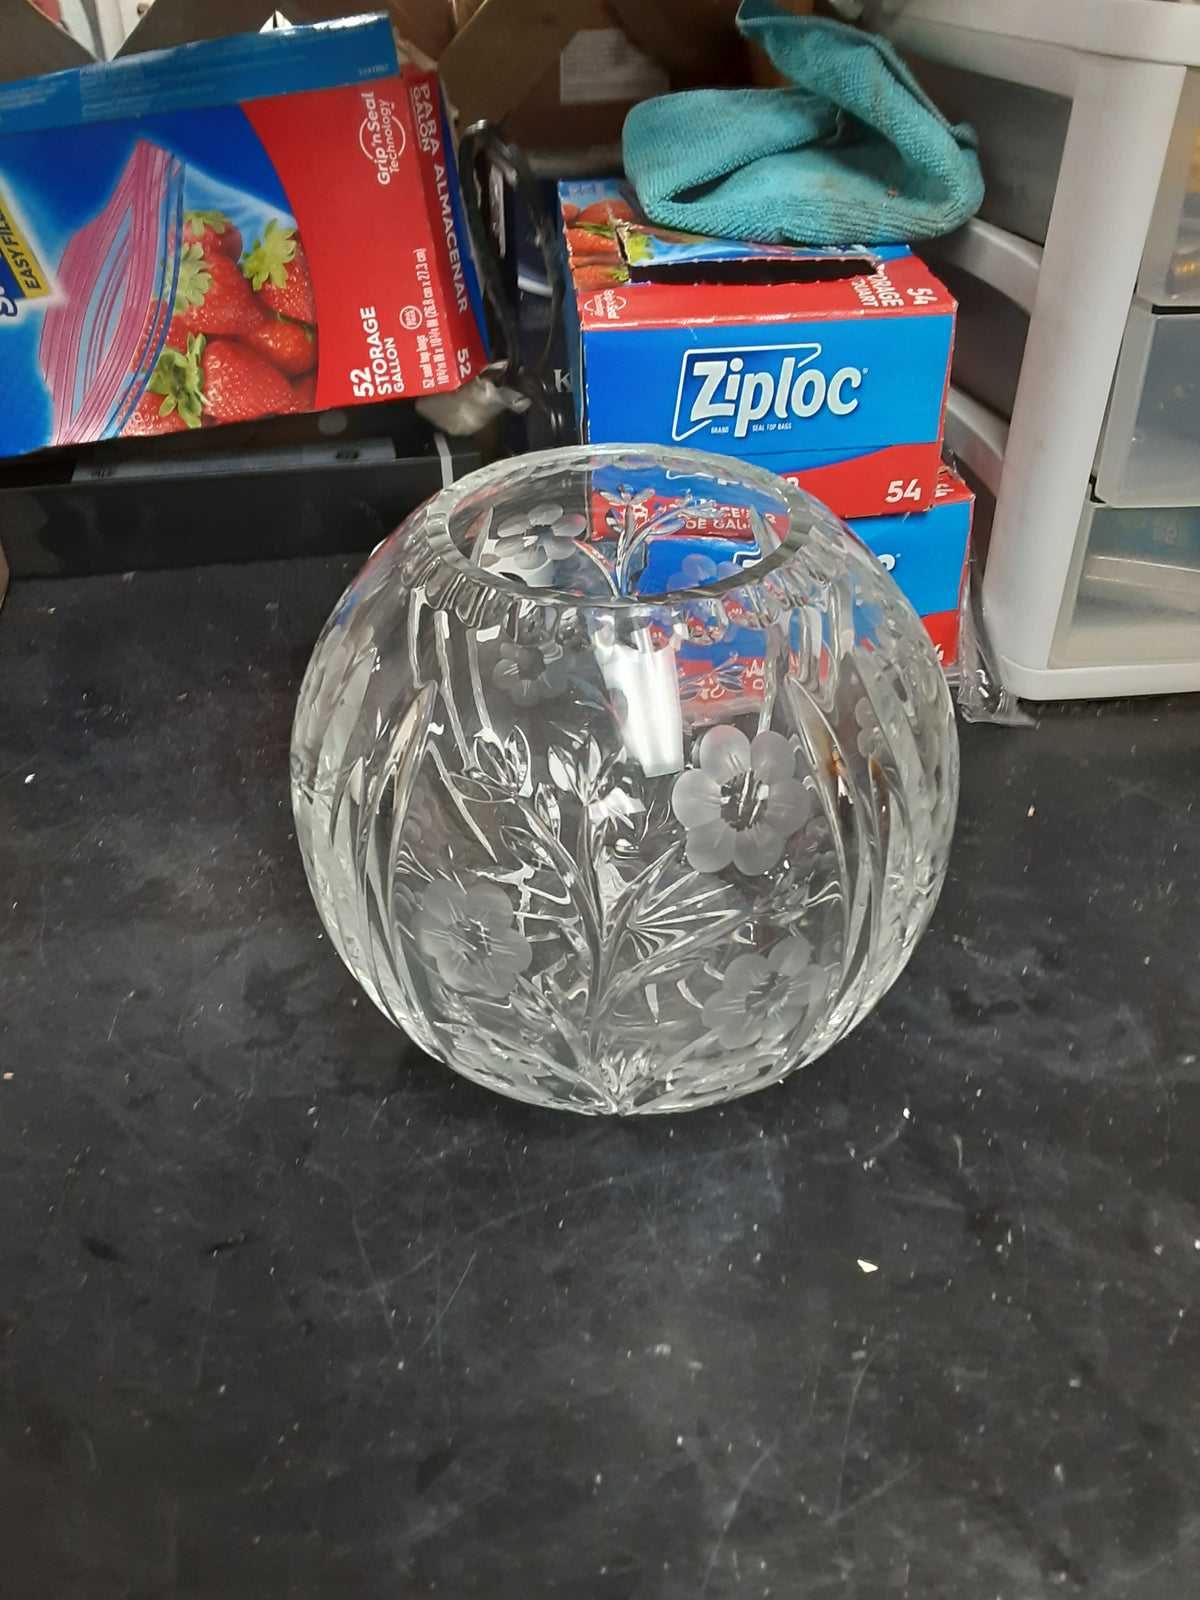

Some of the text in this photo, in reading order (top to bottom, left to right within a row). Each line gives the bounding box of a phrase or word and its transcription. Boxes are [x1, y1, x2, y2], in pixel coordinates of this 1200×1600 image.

[360, 90, 381, 132] Seal
[378, 98, 400, 174] Technology
[418, 81, 469, 315] PARA ALMACENAR
[7, 248, 42, 290] EASY
[906, 288, 938, 305] 54
[360, 306, 392, 395] STORAGE
[384, 337, 405, 393] GALLON
[455, 347, 472, 381] 52
[350, 366, 375, 397] 52
[690, 357, 862, 437] Ziploc
[752, 424, 765, 432] SEAL
[777, 422, 792, 431] BAGS
[885, 478, 922, 503] 54
